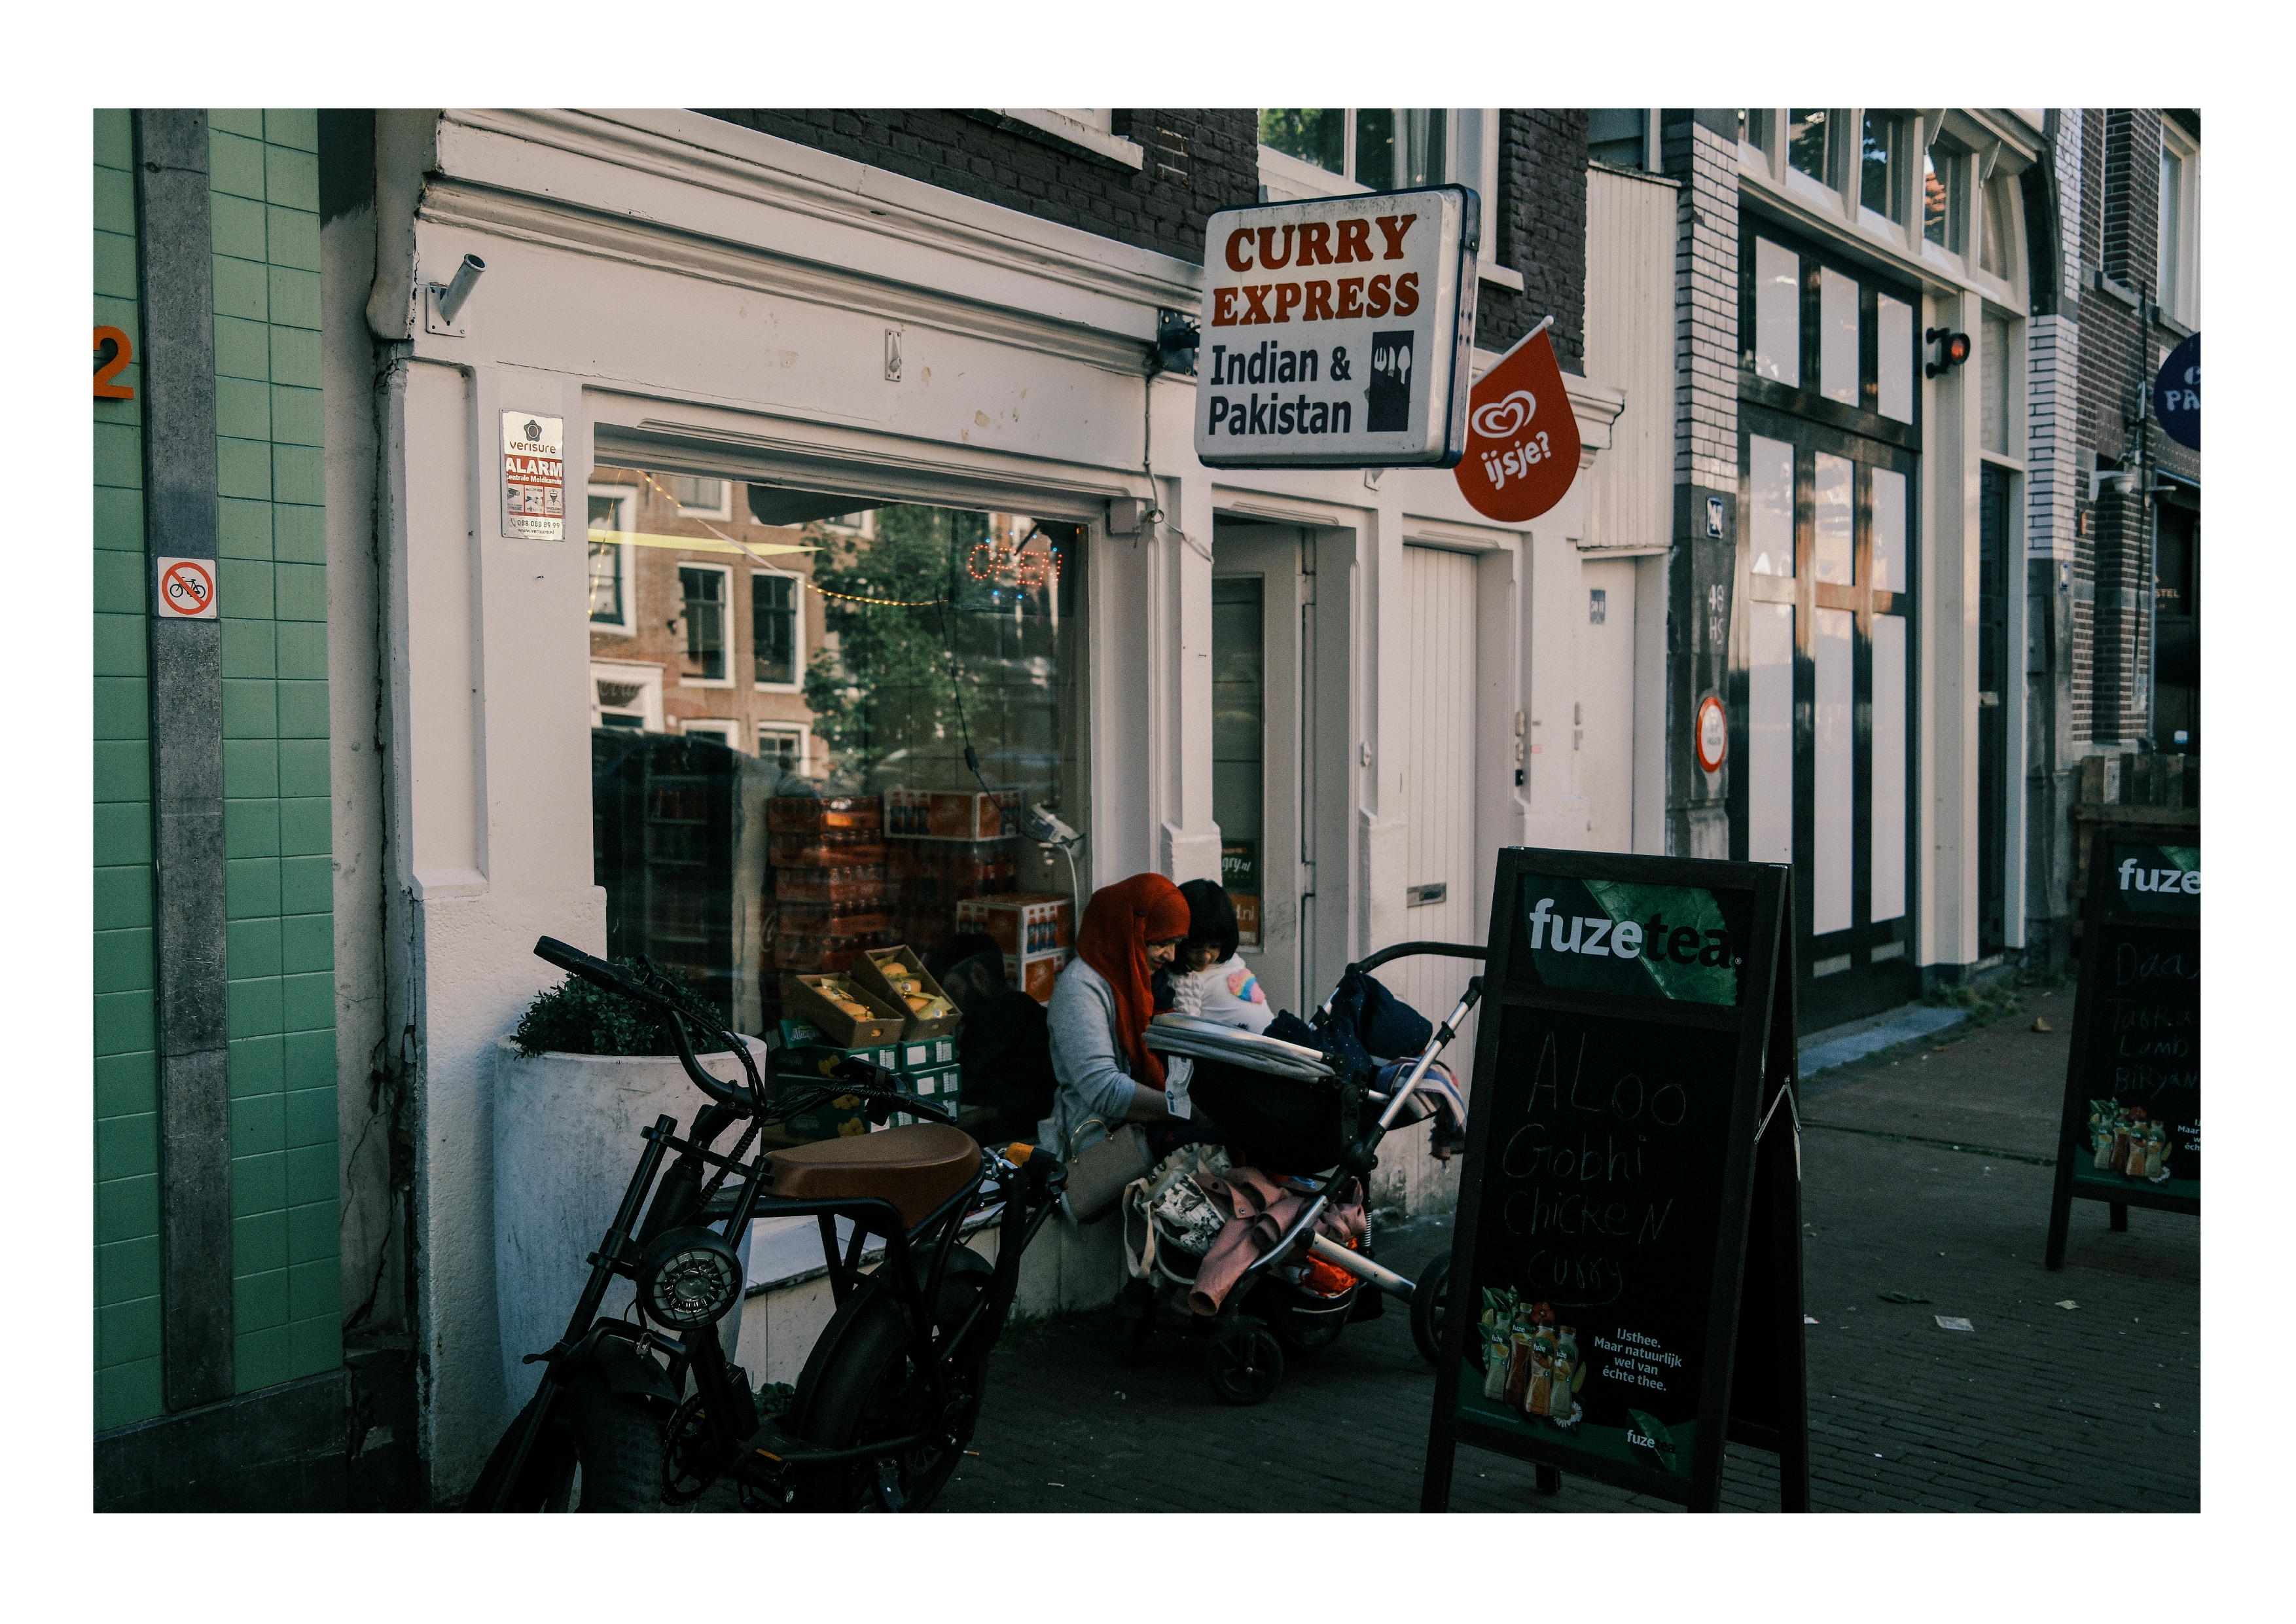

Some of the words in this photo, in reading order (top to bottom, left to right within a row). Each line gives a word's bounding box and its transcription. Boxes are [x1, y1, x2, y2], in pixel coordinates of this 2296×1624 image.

[1225, 213, 1418, 272] CURRY
[1211, 272, 1420, 327] EXPRESS
[1210, 340, 1318, 386] Indian
[1330, 346, 1352, 381] &
[1208, 392, 1352, 436] Pakistan
[505, 456, 563, 478] ALARM
[509, 441, 556, 454] verisure
[1480, 431, 1552, 490] ijsje?
[969, 544, 1064, 588] OPEN
[2118, 857, 2200, 895] fuze
[1503, 1123, 1647, 1182] Gobhi
[1594, 1335, 1623, 1353] Maar
[1625, 1345, 1682, 1368] natuurlijk
[1617, 1327, 1661, 1348] IJsthee.
[1602, 1365, 1635, 1384] échte
[1637, 1374, 1667, 1391] thee.
[1614, 1356, 1635, 1370] wel
[1638, 1362, 1659, 1375] van
